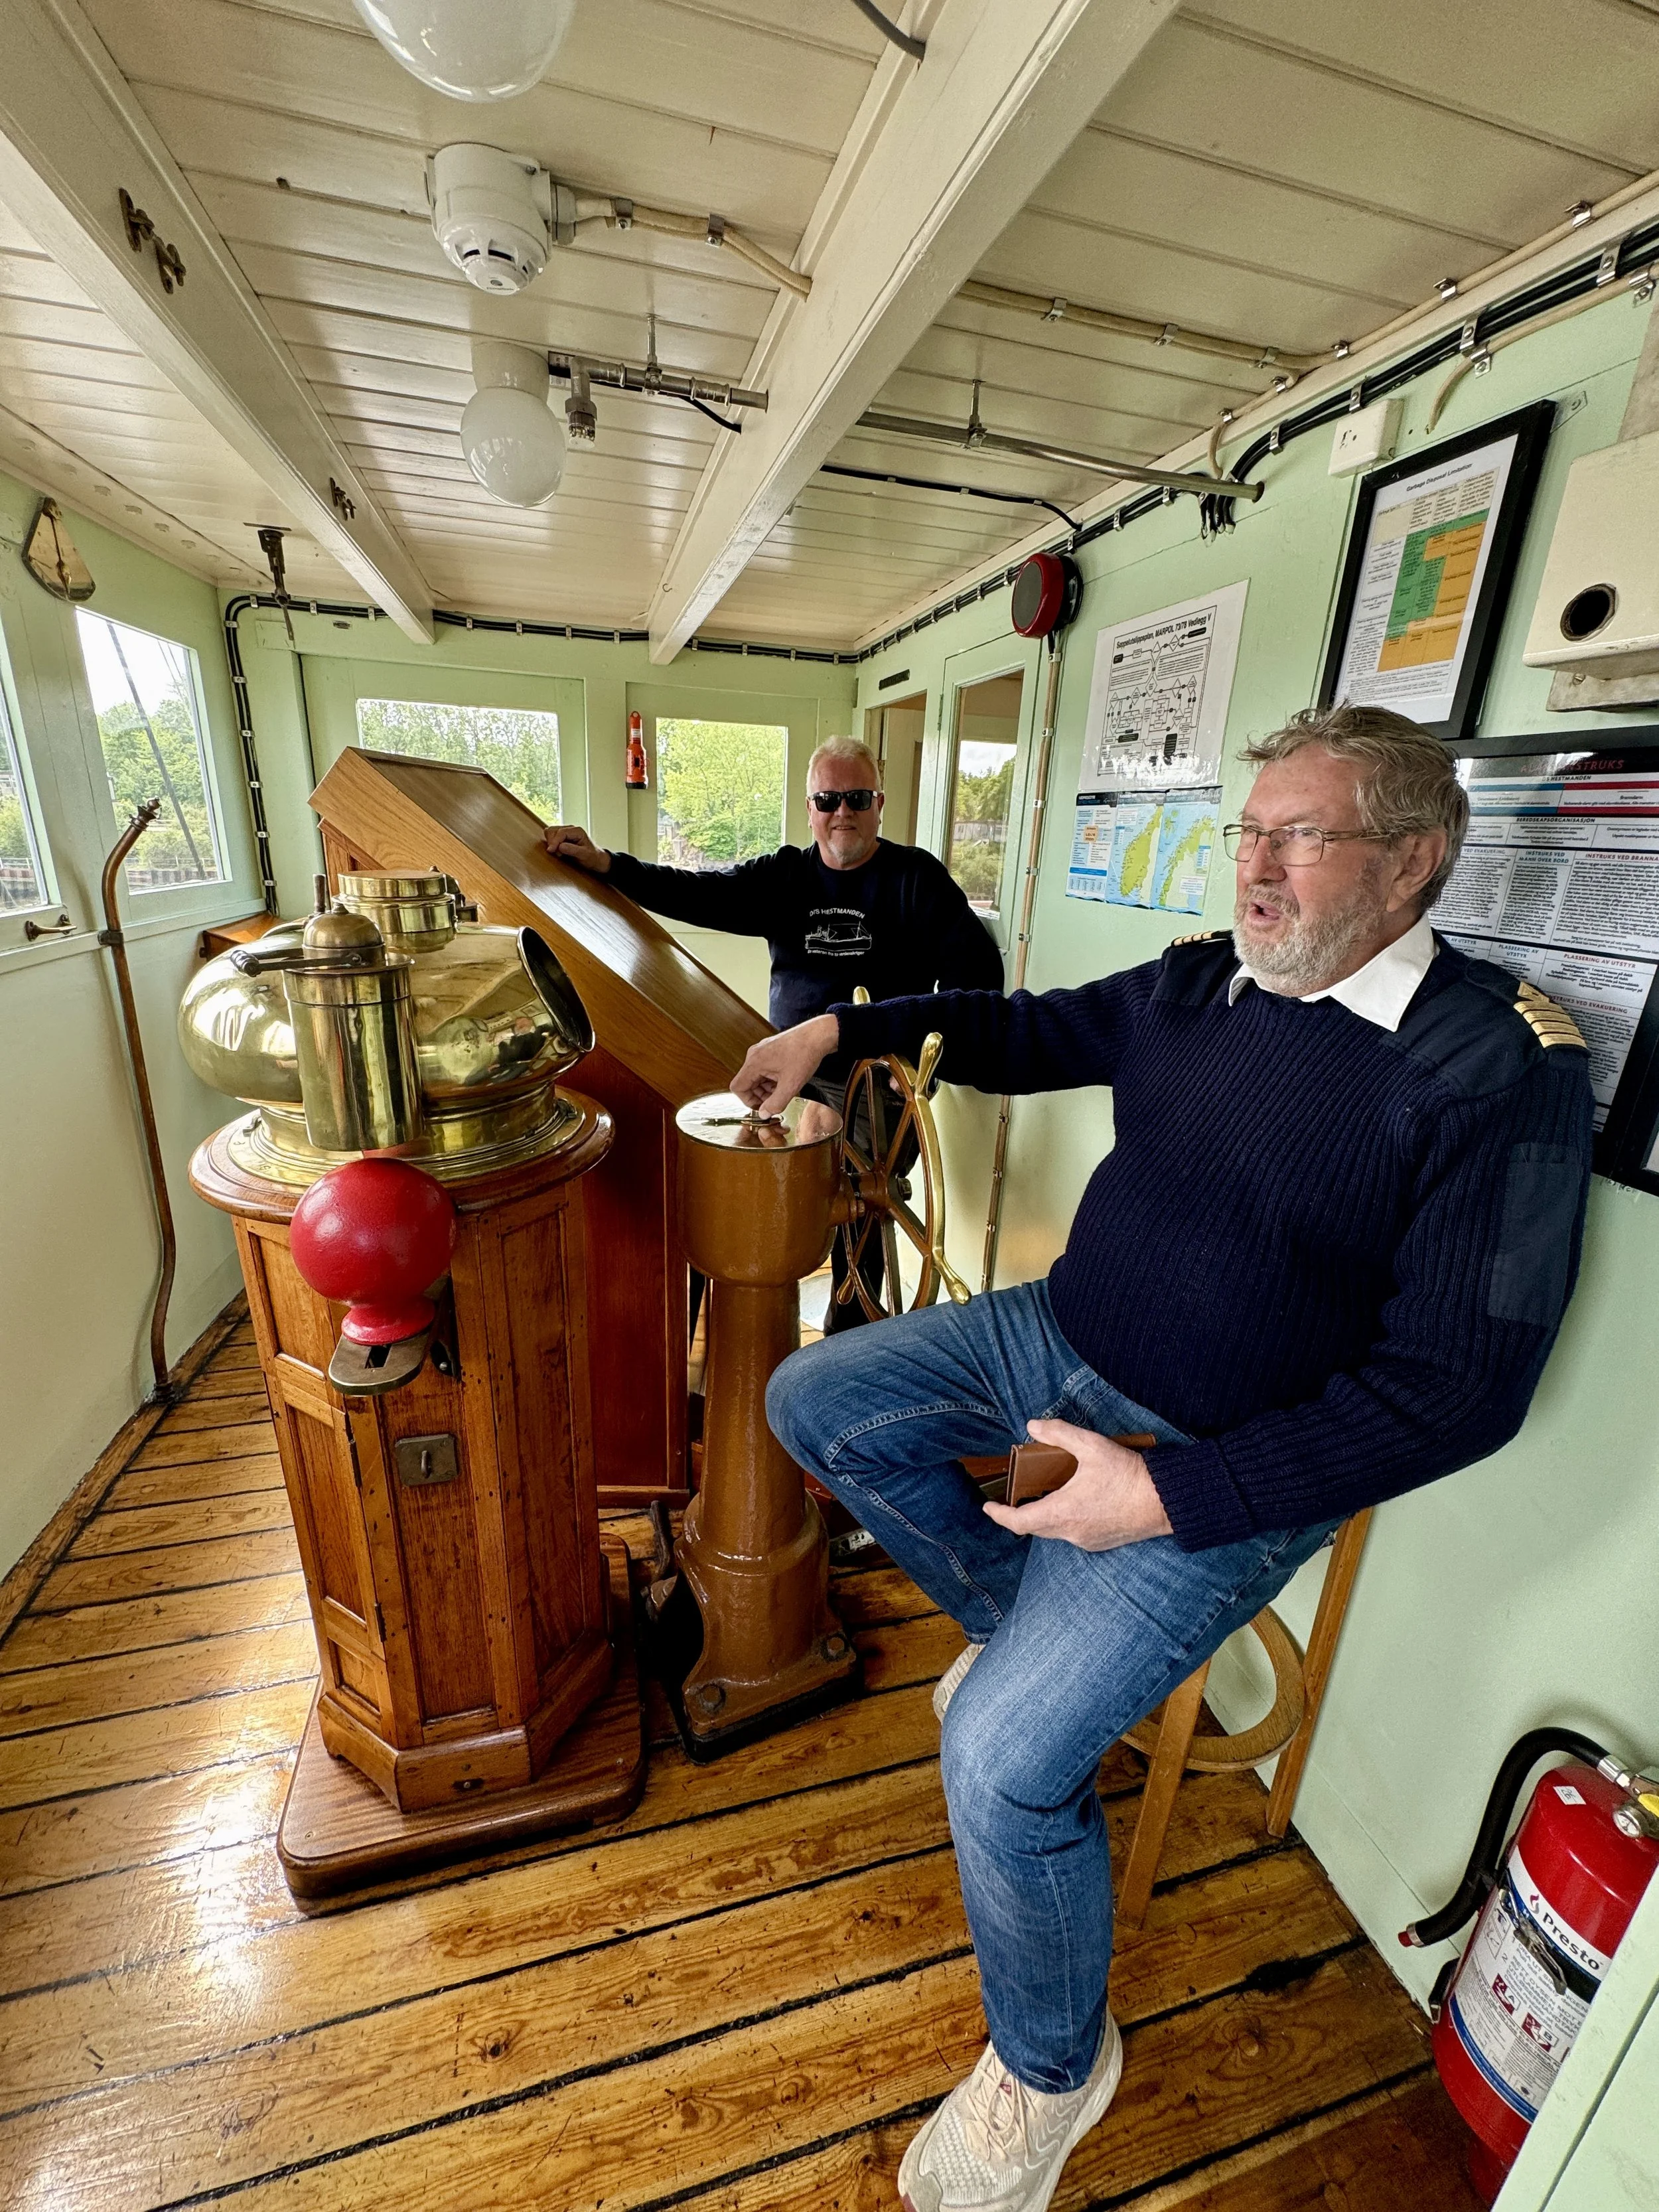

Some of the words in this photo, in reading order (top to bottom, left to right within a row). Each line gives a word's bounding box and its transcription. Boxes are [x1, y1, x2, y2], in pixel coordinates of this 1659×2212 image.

[1406, 481, 1425, 492] Garbage
[1426, 472, 1447, 484] Disposal
[1447, 463, 1473, 477] Limitation
[1155, 626, 1174, 637] MARPOL
[1175, 621, 1187, 631] 73/78
[1188, 615, 1206, 627] Vedlegg
[821, 908, 865, 919] HESTMANDEN
[1563, 954, 1601, 963] PLASSERING
[1589, 1002, 1628, 1013] EVAKUERING
[1542, 1912, 1600, 1970] Presto
[1502, 1953, 1508, 1962] 2
[1544, 2030, 1552, 2041] B
